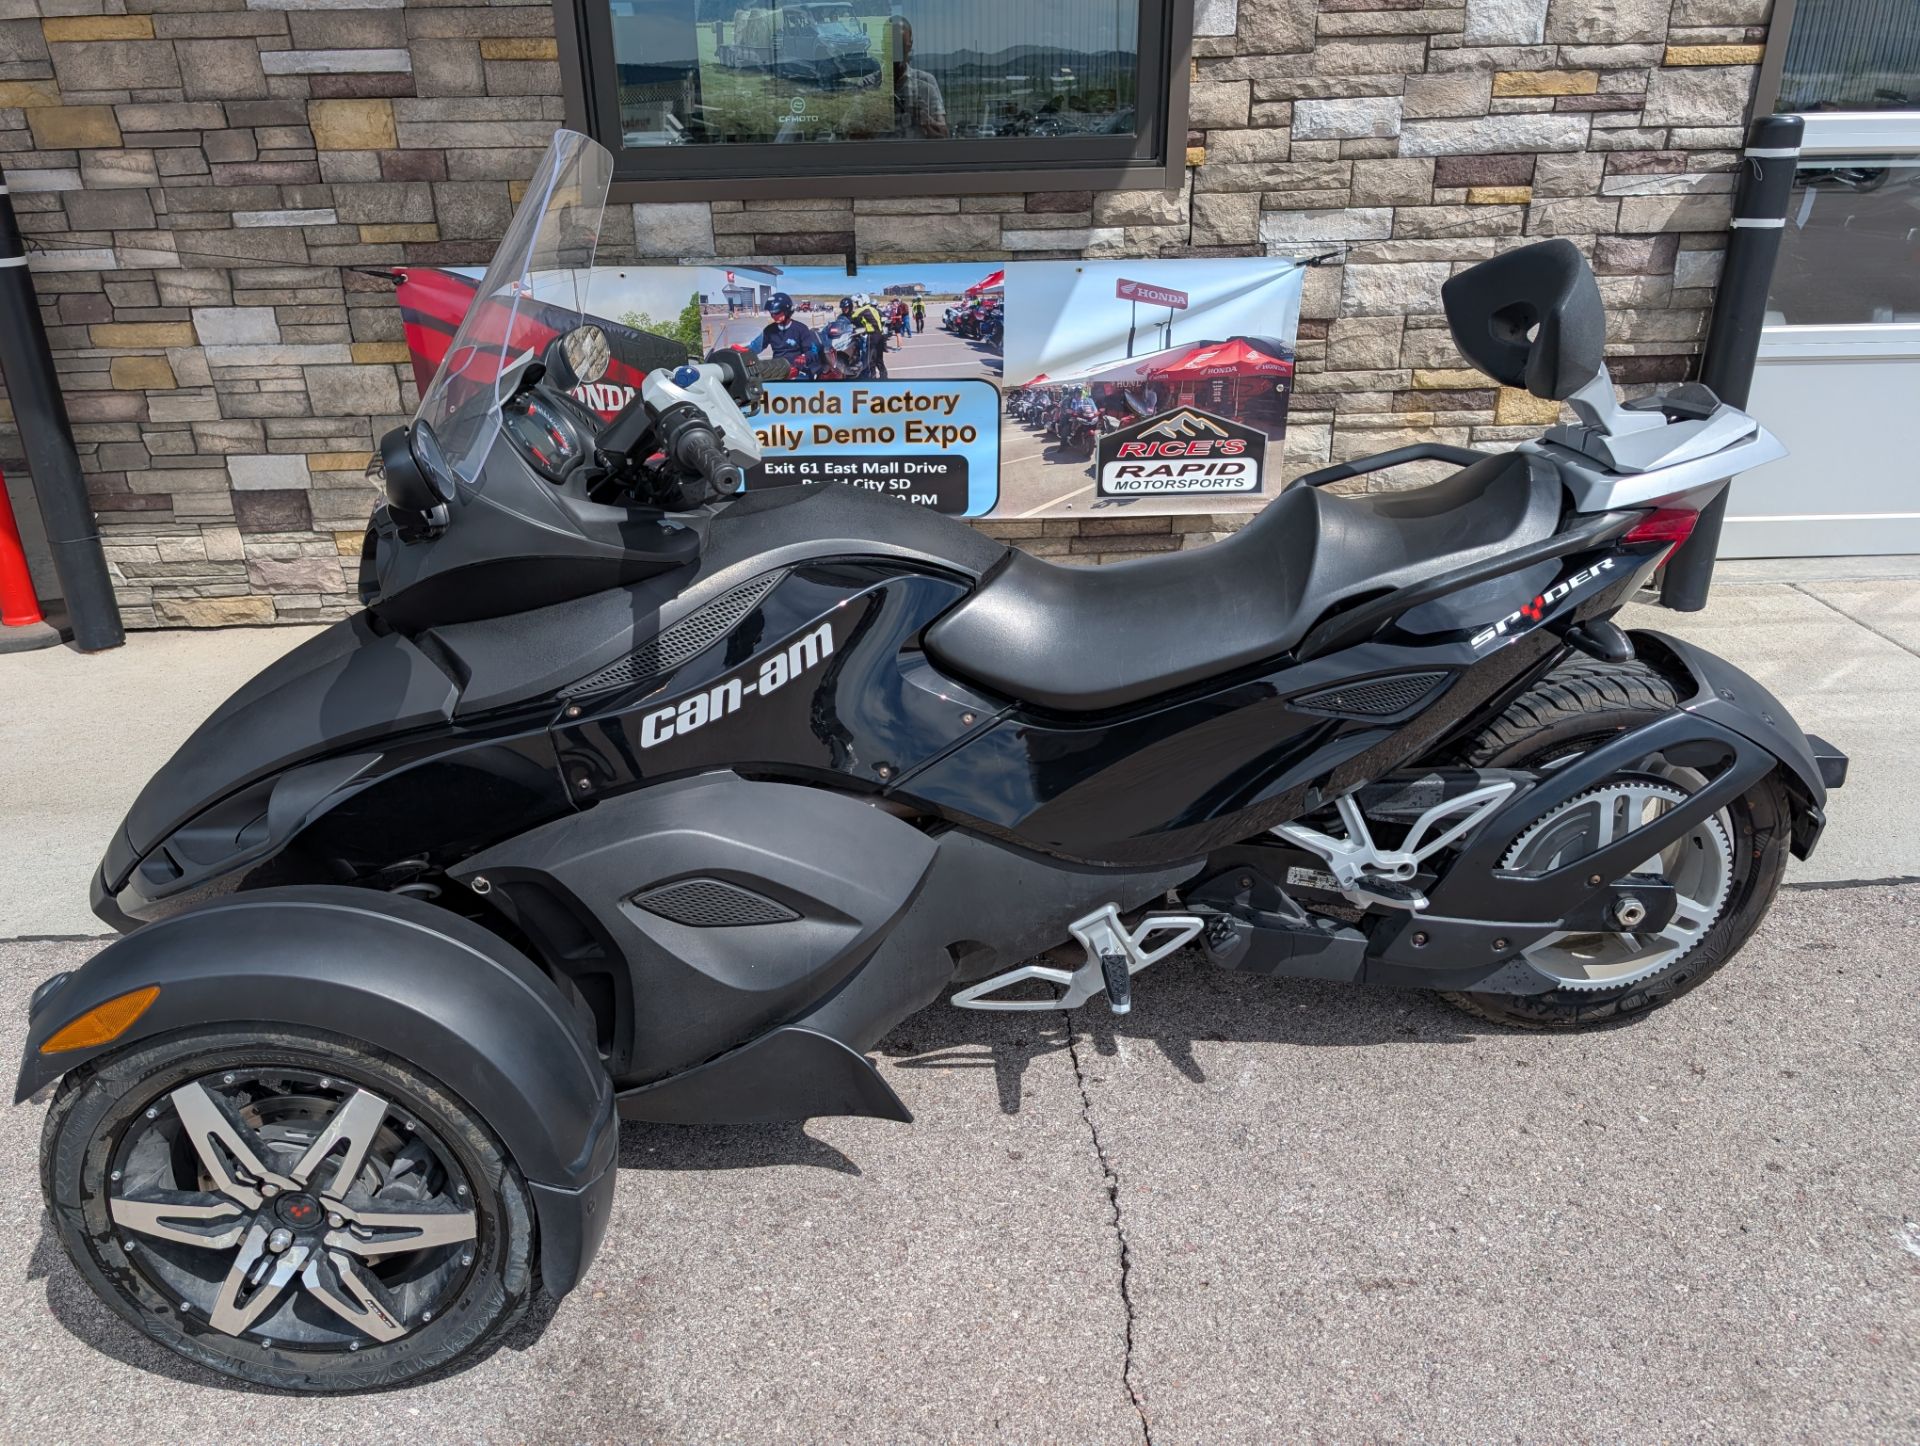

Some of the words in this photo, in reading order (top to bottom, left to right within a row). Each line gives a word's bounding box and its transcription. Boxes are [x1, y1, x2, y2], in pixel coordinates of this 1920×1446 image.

[1137, 287, 1186, 305] HONDA
[1207, 365, 1238, 375] HONDA
[852, 389, 960, 416] Factory
[755, 423, 804, 451] ally
[813, 423, 895, 445] Demo
[905, 420, 977, 449] Expo
[1116, 439, 1248, 458] RICE'S
[764, 463, 795, 474] Exit
[800, 462, 819, 474] 61
[824, 463, 858, 474] East
[862, 462, 899, 474] Mall
[904, 462, 948, 474] Drive
[1115, 462, 1246, 479] RAPID
[854, 478, 885, 492] City
[889, 478, 911, 490] SD
[1114, 478, 1245, 490] MOTORSPORTS
[911, 494, 938, 505] PM
[641, 622, 834, 749] can-am
